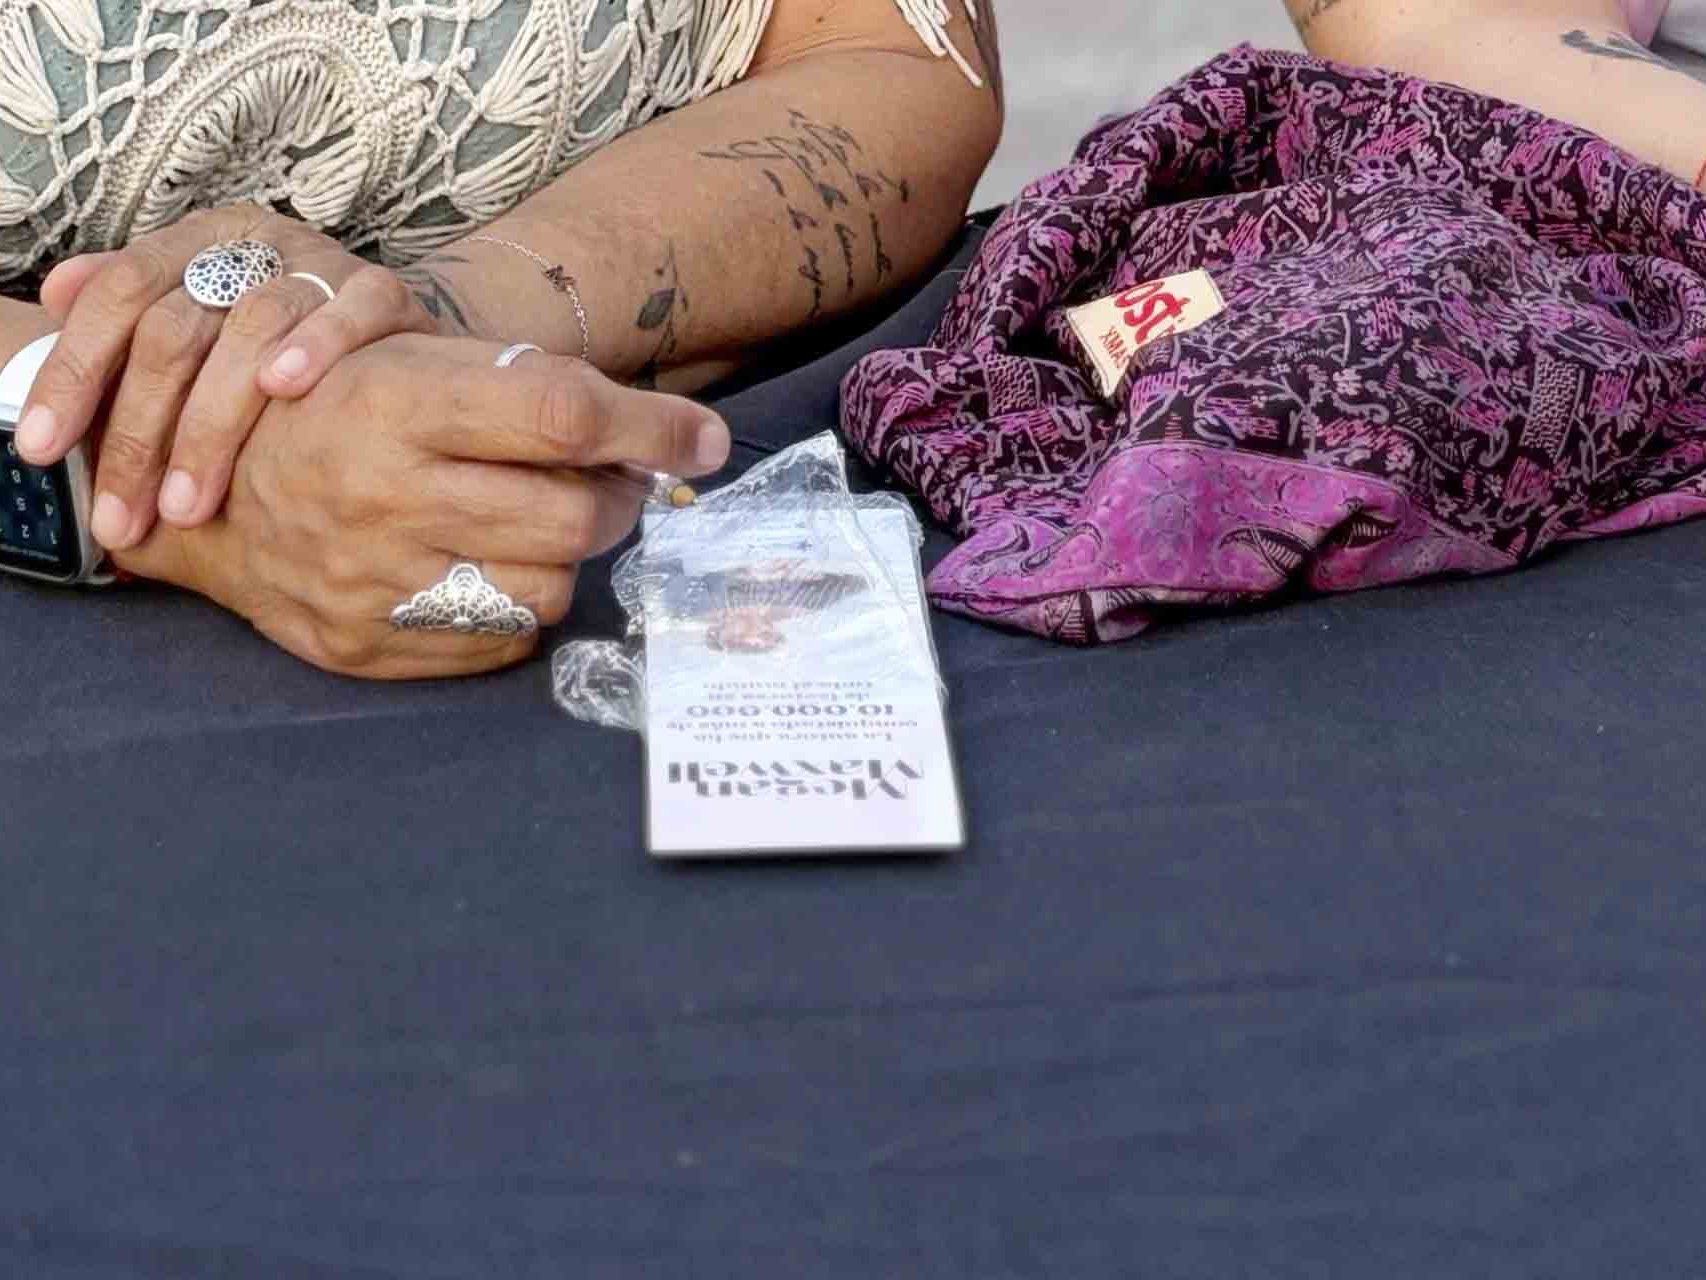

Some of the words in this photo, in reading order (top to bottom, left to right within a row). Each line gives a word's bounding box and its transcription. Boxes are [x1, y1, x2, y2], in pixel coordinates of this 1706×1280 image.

[684, 702, 895, 718] 10.000.000
[667, 759, 926, 784] Maxwell
[695, 778, 908, 801] Megan
